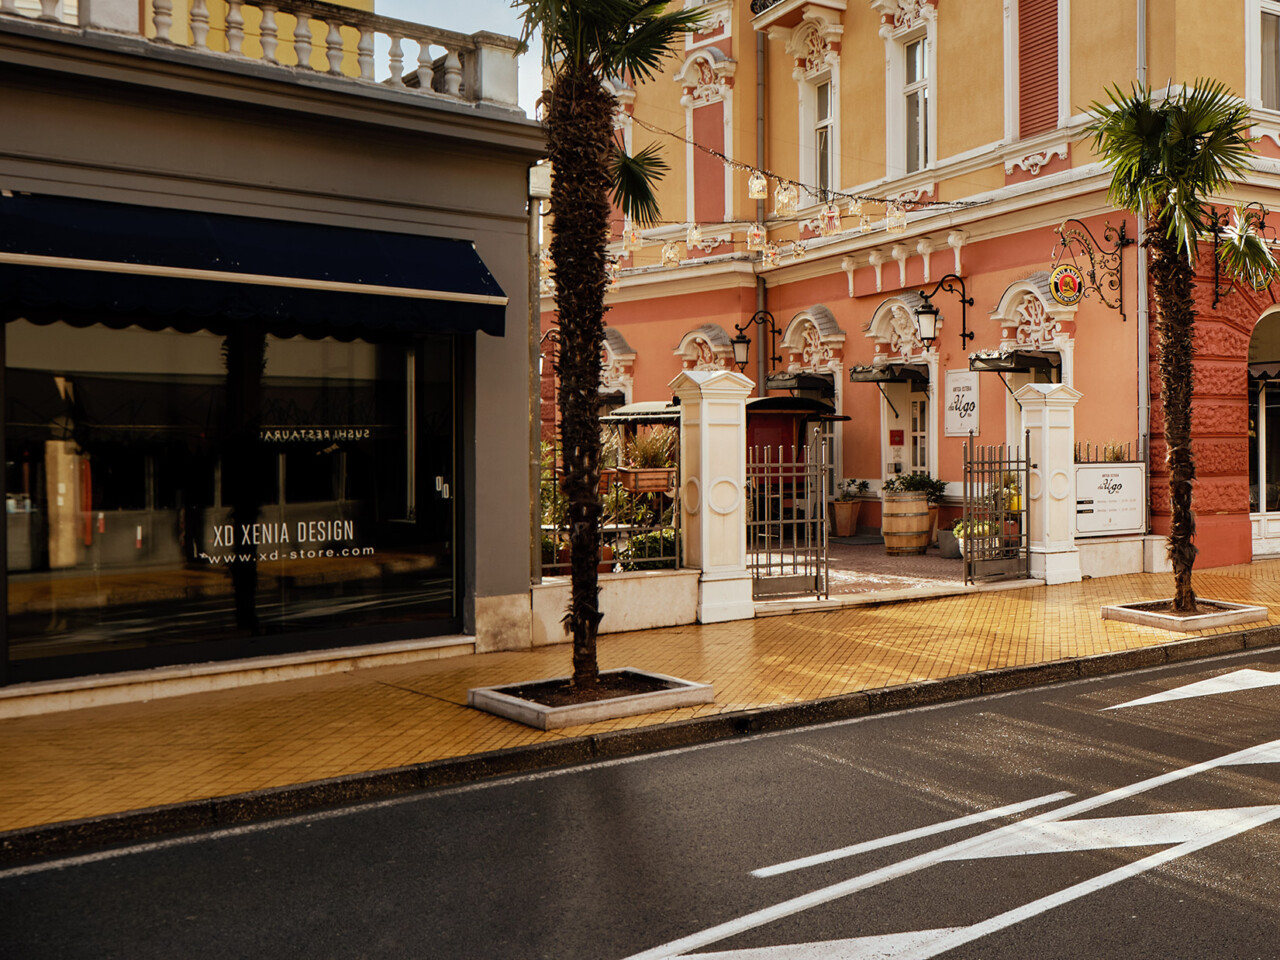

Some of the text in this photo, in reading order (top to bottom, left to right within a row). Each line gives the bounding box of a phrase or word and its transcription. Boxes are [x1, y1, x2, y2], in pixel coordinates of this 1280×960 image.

[1054, 268, 1081, 282] PAULANER
[954, 393, 976, 419] Ugo
[1103, 478, 1123, 495] Ugo
[213, 520, 354, 547] XD XENIA DESIGN
[207, 546, 375, 564] www.xd-store.com
